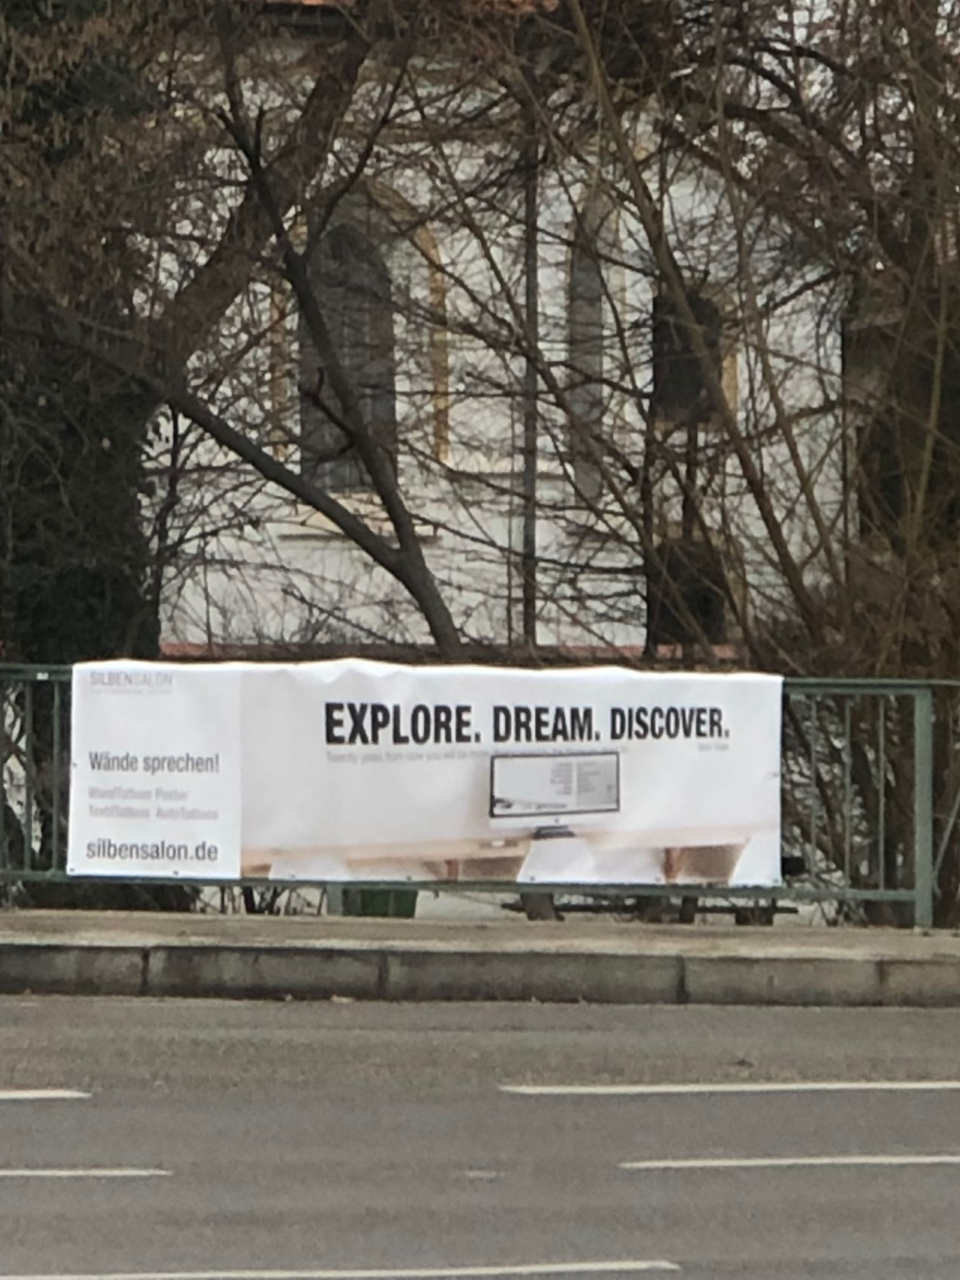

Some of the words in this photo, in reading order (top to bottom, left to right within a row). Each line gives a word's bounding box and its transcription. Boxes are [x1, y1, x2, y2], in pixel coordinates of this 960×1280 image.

[89, 670, 173, 686] SILBENSALON
[325, 701, 481, 745] EXPLORE.
[493, 705, 600, 742] DREAM.
[610, 706, 730, 739] DISCOVER.
[88, 751, 139, 771] Wände
[142, 752, 220, 775] sprechen!
[86, 838, 219, 861] silbensalon.de
